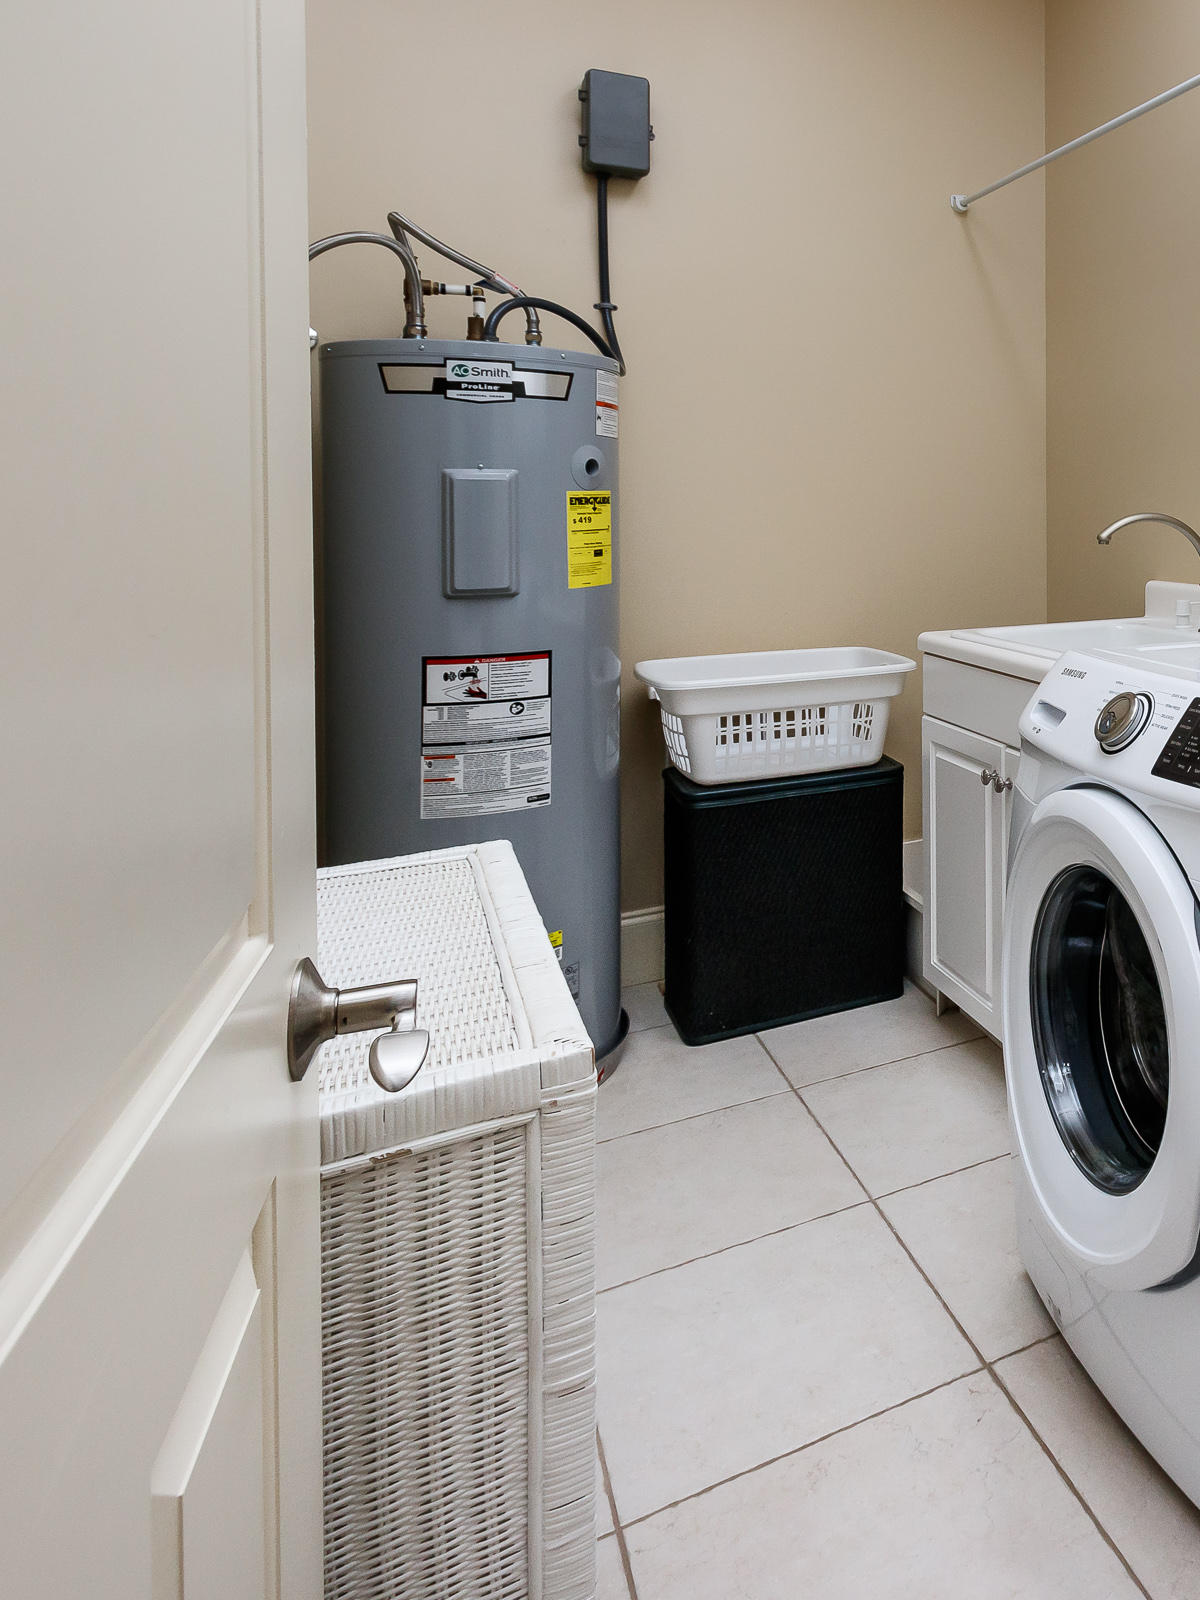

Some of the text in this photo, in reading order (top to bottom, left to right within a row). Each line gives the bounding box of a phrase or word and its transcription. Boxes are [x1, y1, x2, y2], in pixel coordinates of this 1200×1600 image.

[471, 366, 509, 378] Smith
[461, 383, 500, 391] ProLine
[578, 516, 592, 524] 419
[1061, 667, 1087, 680] SAMSUNG
